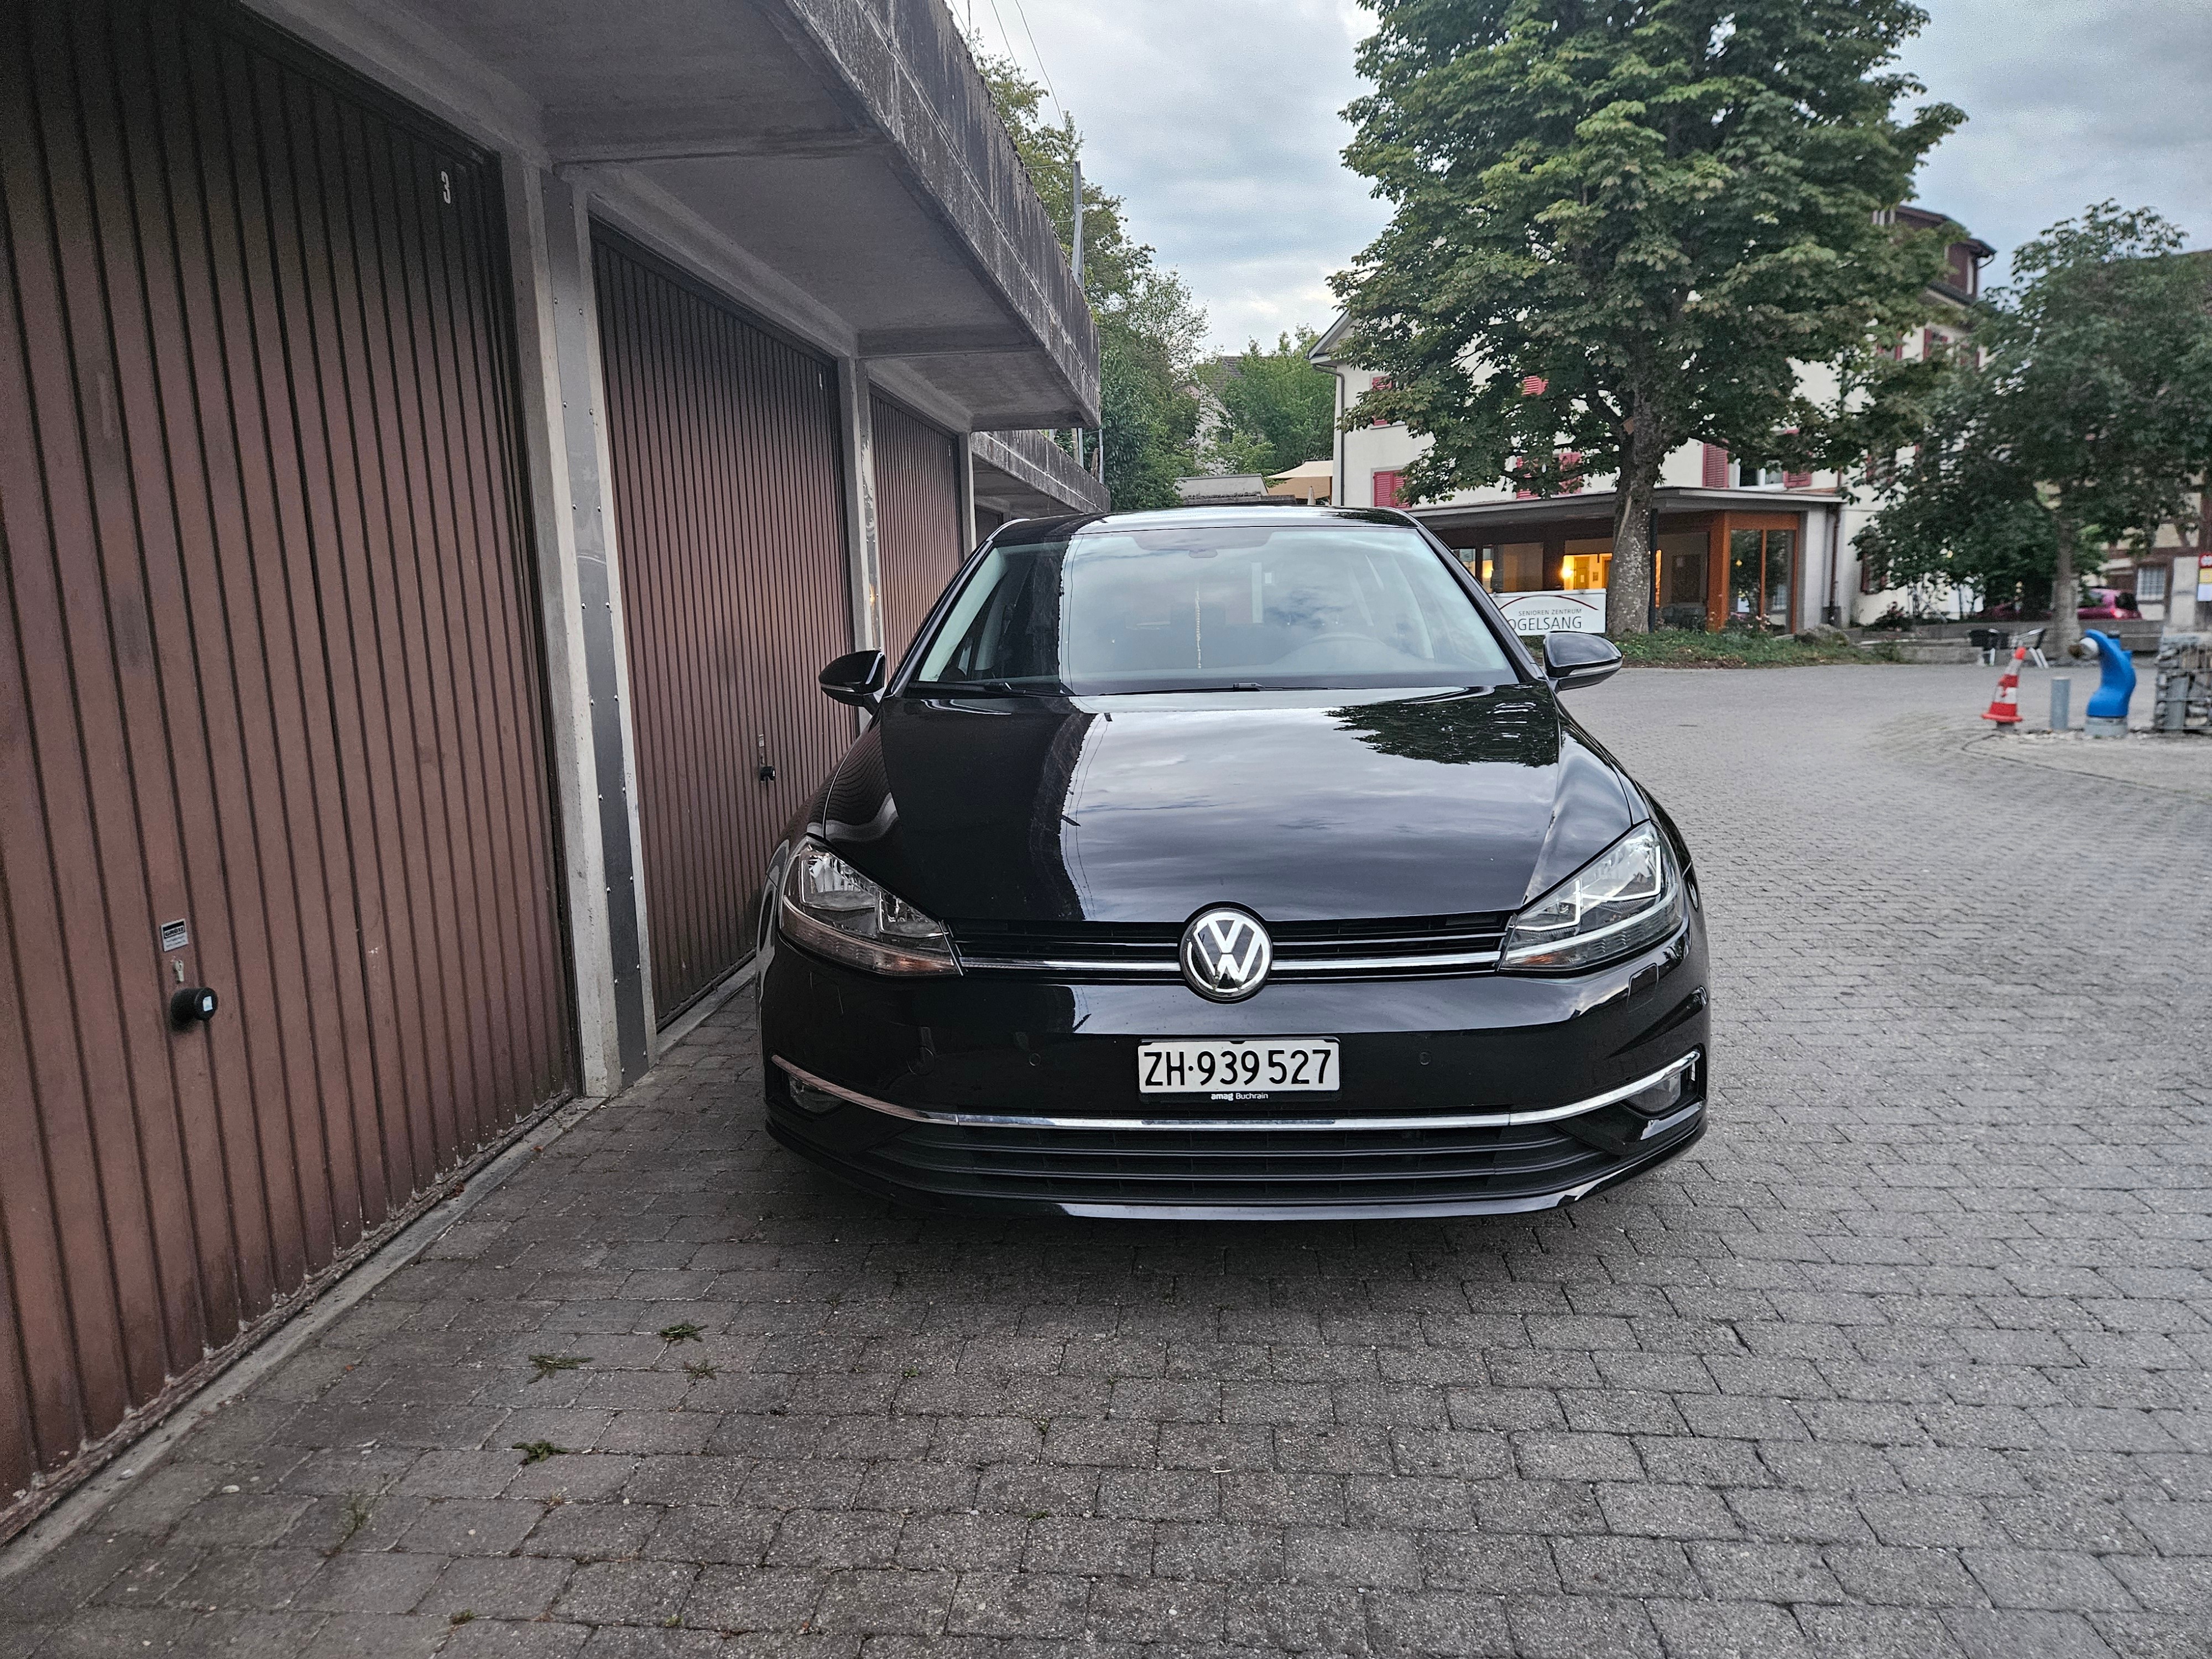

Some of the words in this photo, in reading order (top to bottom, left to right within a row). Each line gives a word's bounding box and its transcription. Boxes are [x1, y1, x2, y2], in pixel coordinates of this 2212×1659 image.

[441, 171, 451, 204] 3
[1507, 617, 1582, 630] OGELSANG
[1211, 1093, 1234, 1101] amag
